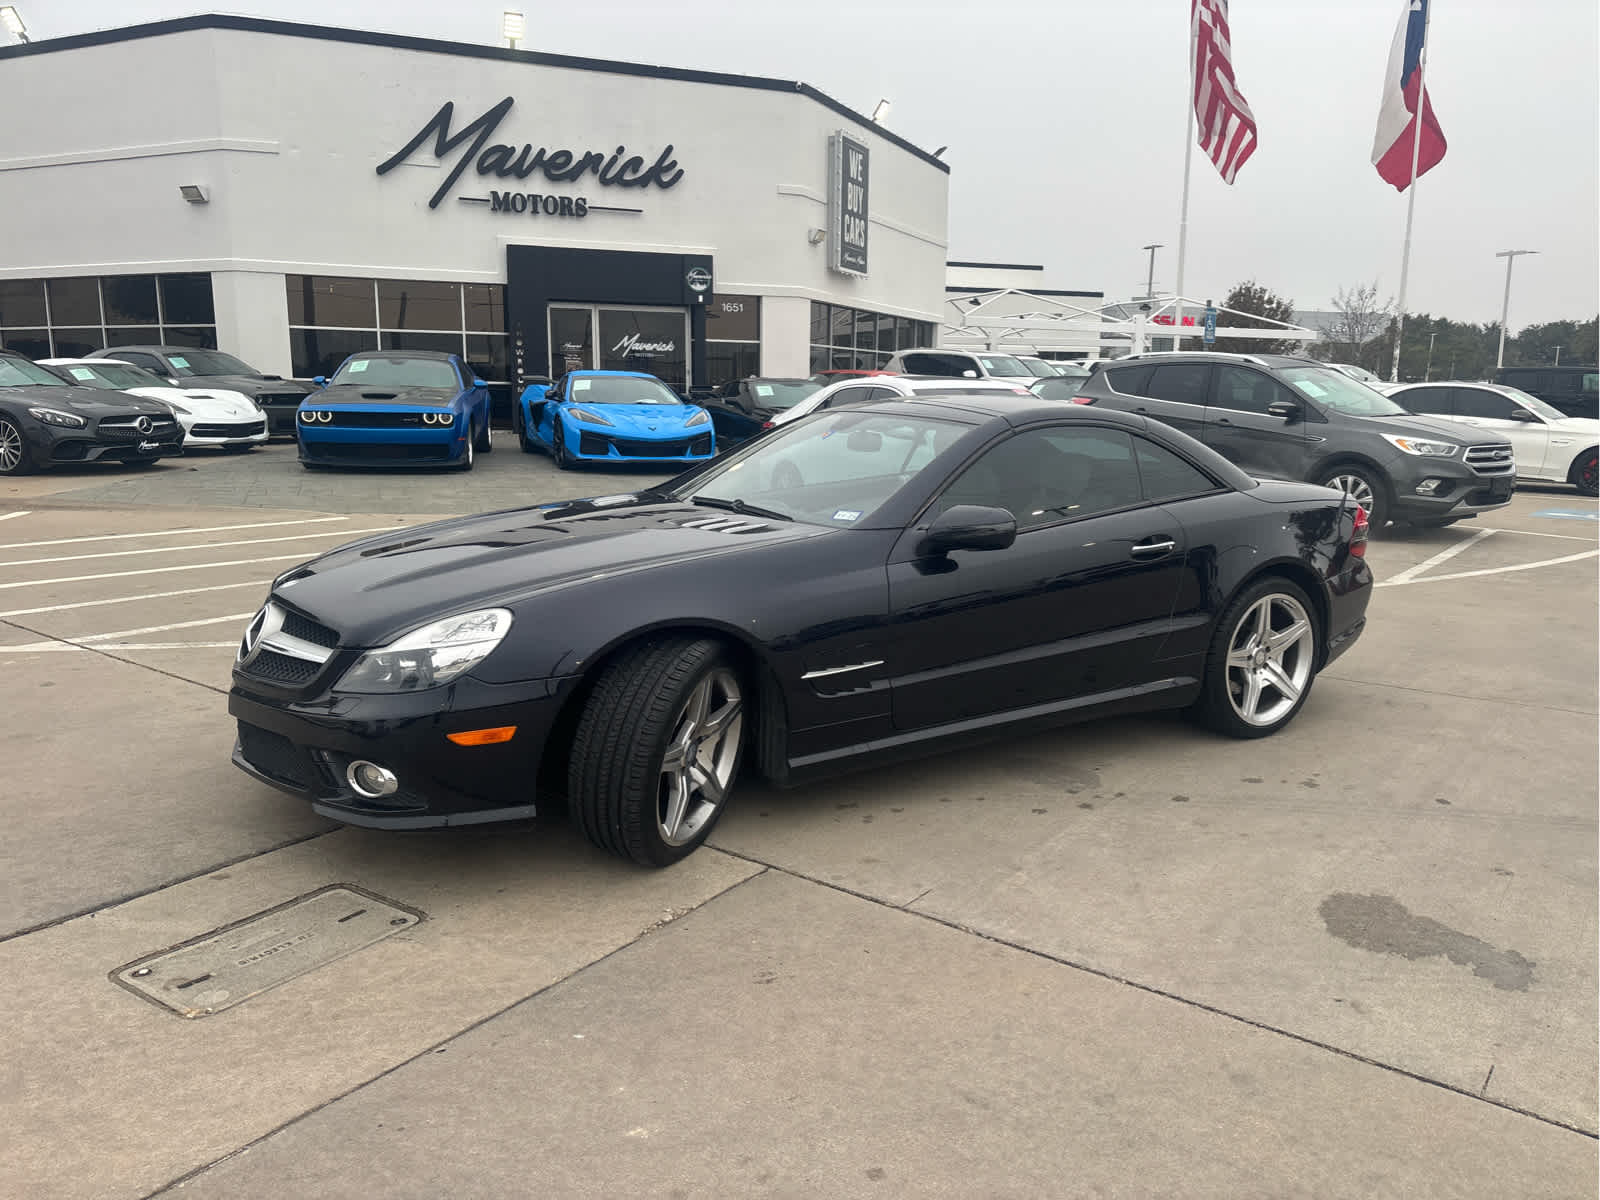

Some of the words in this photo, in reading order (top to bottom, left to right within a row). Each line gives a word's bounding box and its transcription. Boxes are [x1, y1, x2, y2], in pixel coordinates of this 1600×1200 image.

[376, 95, 685, 210] Maverick
[849, 149, 863, 181] WE
[489, 190, 589, 218] MOTORS
[848, 182, 864, 214] BUY
[844, 214, 865, 247] CARS
[721, 302, 745, 313] 1651
[612, 333, 675, 358] Maverick
